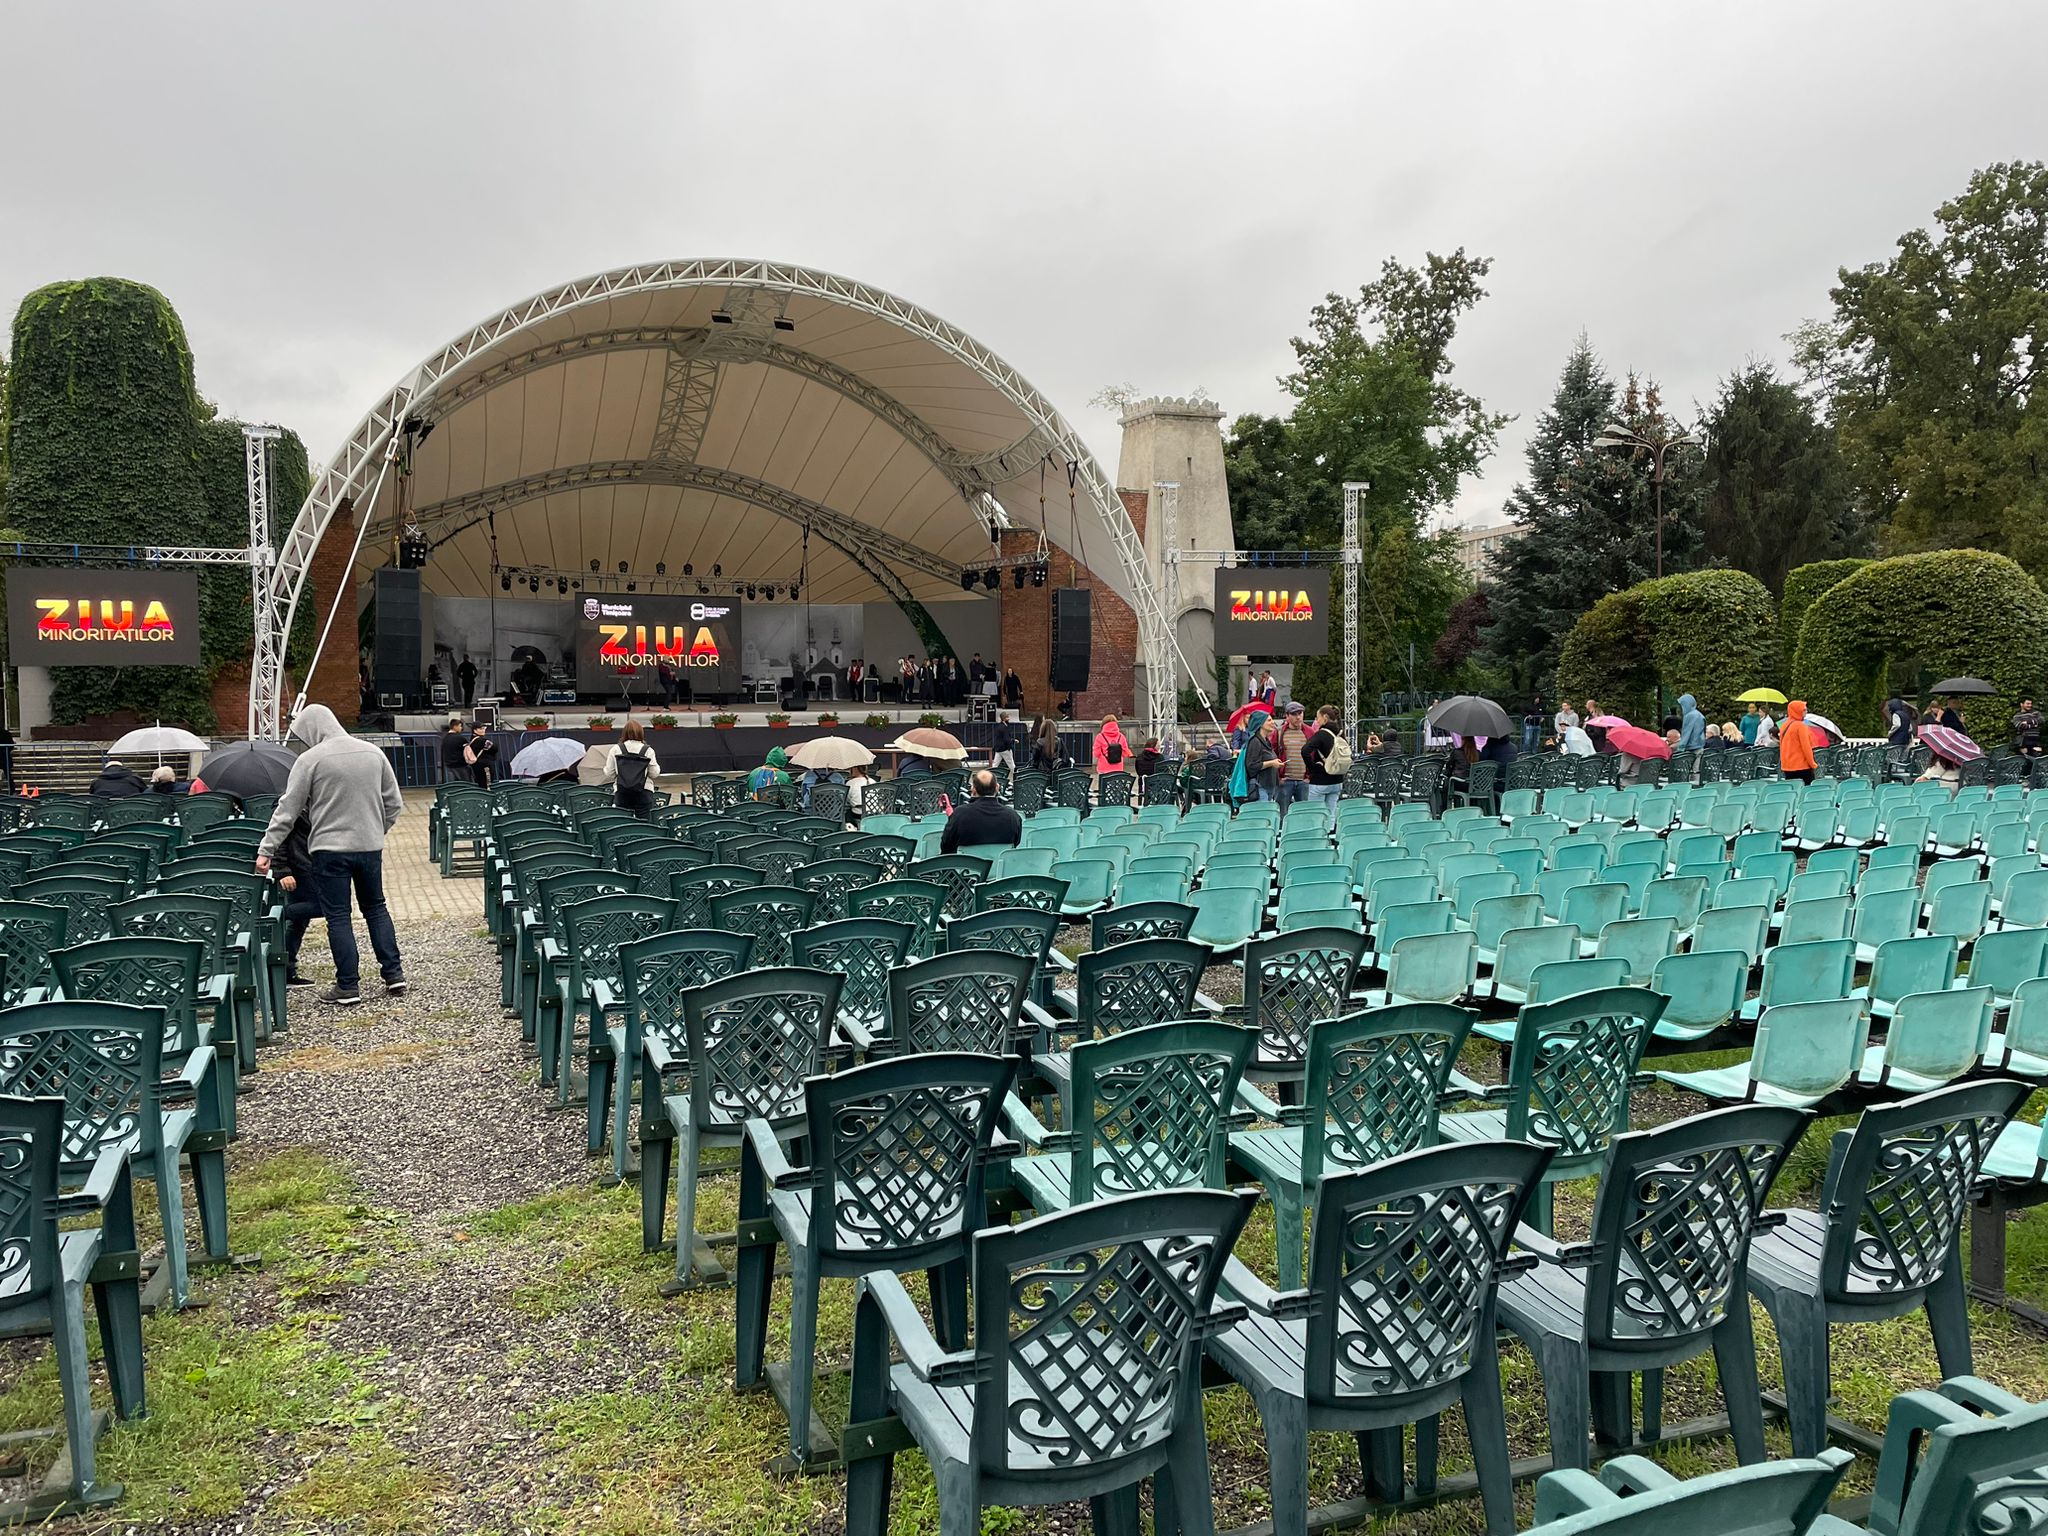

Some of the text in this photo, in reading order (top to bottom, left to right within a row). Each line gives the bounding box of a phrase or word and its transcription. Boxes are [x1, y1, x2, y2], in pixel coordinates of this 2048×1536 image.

[35, 599, 174, 630] ZIUA
[1230, 590, 1313, 612] ZIUA
[599, 624, 720, 655] ZIUA
